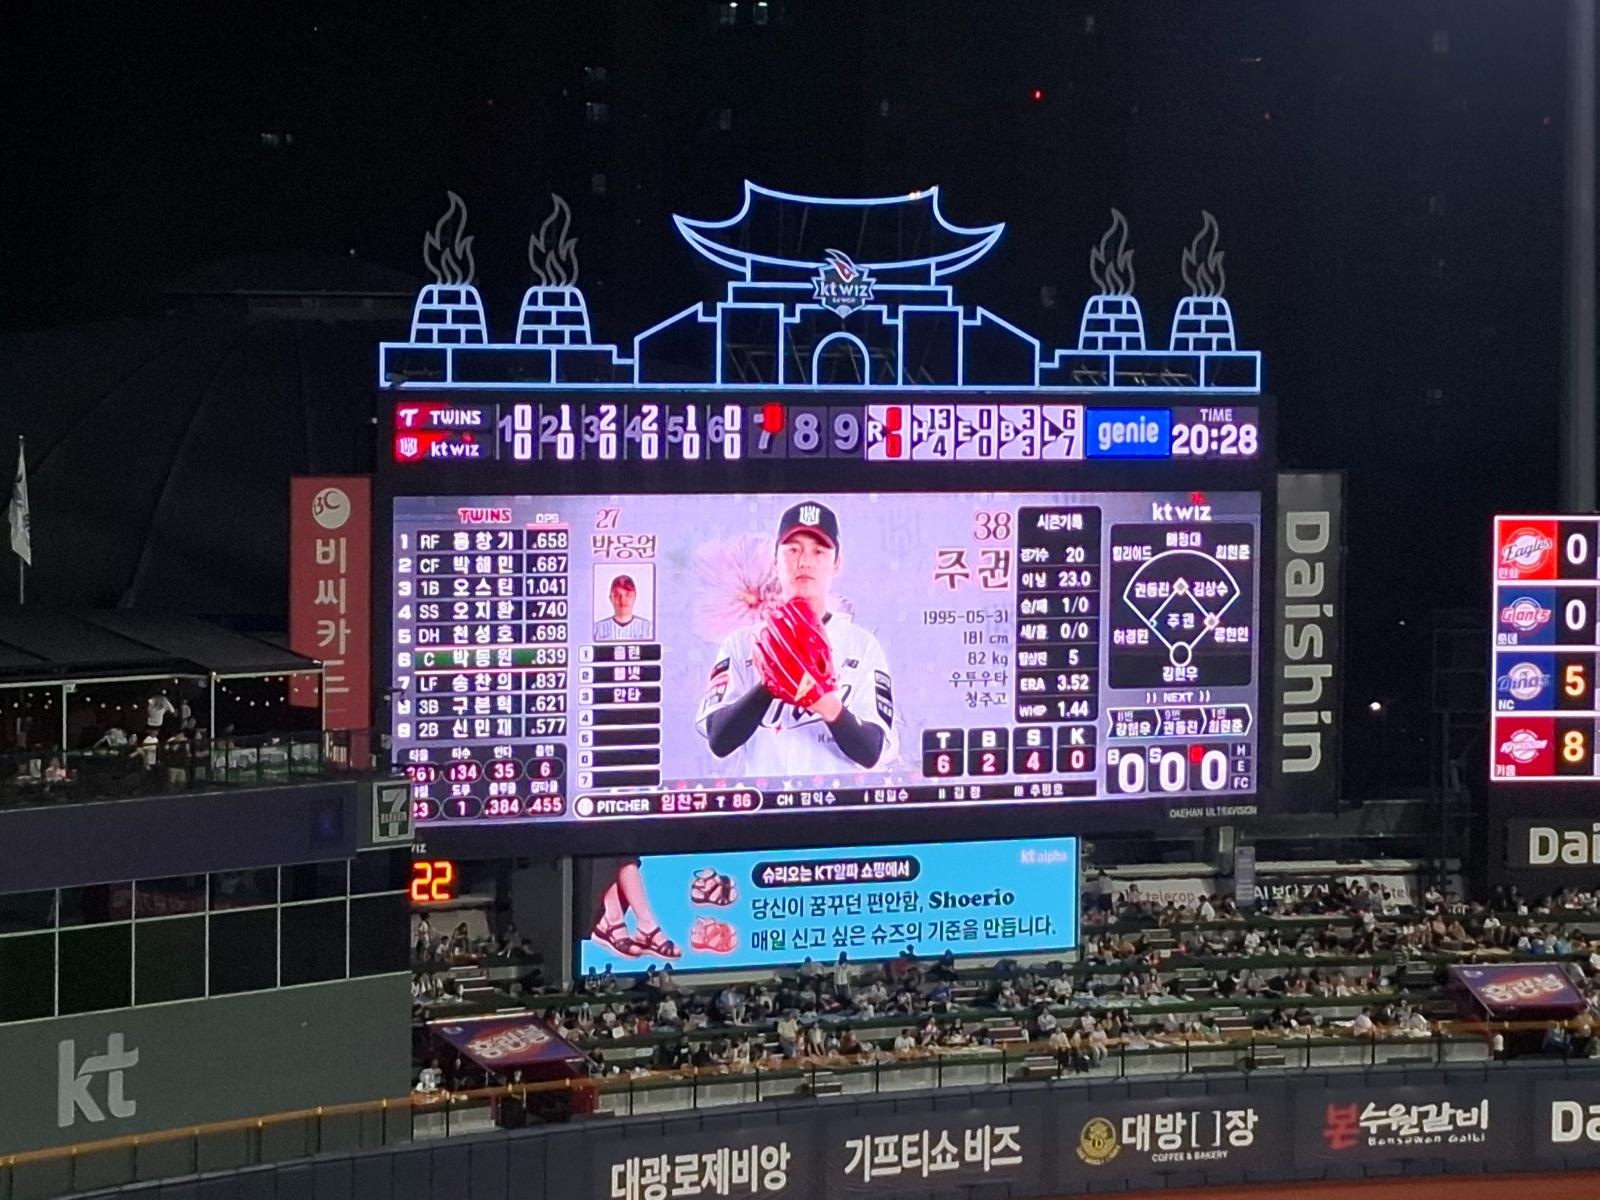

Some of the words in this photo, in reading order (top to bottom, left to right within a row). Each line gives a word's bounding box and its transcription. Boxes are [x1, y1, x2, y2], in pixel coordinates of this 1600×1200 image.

[839, 284, 868, 296] wiz
[430, 410, 481, 425] TWINS
[514, 404, 531, 430] 0
[560, 404, 571, 430] 1
[600, 404, 616, 430] 2
[641, 405, 658, 431] 2
[686, 405, 696, 431] 1
[724, 405, 741, 431] 0
[979, 409, 991, 430] 0
[1022, 409, 1035, 430] 3
[1063, 408, 1076, 430] 6
[1200, 408, 1232, 422] TIME
[794, 413, 819, 450] 8
[834, 413, 858, 450] 9
[868, 421, 883, 441] R
[913, 421, 928, 441] H
[958, 422, 972, 442] E
[1001, 422, 1015, 442] B
[1044, 421, 1057, 442] L
[1098, 415, 1159, 451] genie
[1172, 424, 1258, 455] 20:28
[431, 442, 448, 456] kt
[449, 444, 479, 456] wiz
[514, 433, 531, 459] 0
[557, 433, 574, 459] 0
[600, 433, 616, 459] 0
[641, 433, 658, 459] 0
[683, 433, 699, 459] 0
[724, 433, 741, 459] 0
[933, 435, 947, 457] 4
[979, 436, 991, 457] 0
[1022, 436, 1035, 457] 3
[1063, 436, 1076, 457] 7
[458, 508, 512, 524] TWINS
[596, 508, 620, 529] 27
[1152, 502, 1173, 521] kt
[1174, 505, 1212, 521] wiz
[974, 511, 1011, 541] 38
[400, 534, 408, 549] 1
[420, 534, 440, 549] RF
[532, 532, 567, 549] .658
[592, 535, 656, 559] 박동원
[1503, 537, 1552, 561] Eagles
[1567, 533, 1588, 564] 0
[1066, 547, 1084, 562] 20
[398, 558, 412, 573] 2
[420, 559, 440, 573] CF
[532, 556, 567, 572] .687
[398, 581, 411, 596] 3
[421, 581, 440, 595] 1B
[453, 578, 514, 596] 오스틴
[527, 579, 566, 594] 1.041
[1058, 571, 1091, 587] 23.0
[398, 605, 411, 619] 4
[419, 604, 439, 619] SS
[532, 602, 567, 618] .740
[1062, 597, 1088, 613] 1/0
[924, 610, 1008, 624] 1995-05-31
[1566, 599, 1586, 630] 0
[398, 628, 411, 644] 5
[419, 628, 440, 643] DH
[531, 625, 567, 641] .698
[963, 631, 982, 644] 181
[989, 634, 1008, 644] cm
[1060, 622, 1088, 639] 0/0
[1282, 511, 1333, 773] Daishin
[398, 652, 411, 667] 6
[424, 653, 435, 666] C
[531, 649, 566, 665] .839
[968, 652, 986, 665] 82
[992, 651, 1008, 667] kg
[1068, 649, 1079, 665] 5
[420, 676, 438, 691] LF
[531, 673, 566, 689] .837
[949, 670, 1008, 688] 우투우타
[1020, 678, 1045, 691] ERA
[1057, 674, 1089, 691] 3.52
[1565, 666, 1585, 696] 5
[419, 700, 439, 714] 3B
[531, 696, 564, 712] .621
[1163, 692, 1193, 703] NEXT
[1499, 700, 1515, 710] NC
[1058, 700, 1088, 717] 1.44
[419, 723, 439, 737] 2B
[531, 718, 565, 735] .577
[936, 732, 950, 749] T
[982, 730, 996, 747] B
[1027, 729, 1041, 746] S
[1071, 728, 1084, 745] K
[1564, 731, 1584, 762] 8
[1237, 745, 1246, 756] H
[494, 763, 514, 778] 35
[541, 762, 550, 776] 6
[937, 755, 950, 774] 6
[982, 753, 996, 772] 2
[1027, 751, 1040, 770] 4
[1071, 750, 1084, 769] 0
[1107, 749, 1120, 765] B
[1118, 753, 1145, 793] 0
[1149, 748, 1162, 763] S
[1159, 751, 1185, 791] 0
[1201, 750, 1227, 790] 0
[1237, 761, 1245, 772] E
[450, 764, 477, 781] 134
[1233, 777, 1249, 788] FC
[458, 801, 466, 816] 1
[485, 800, 520, 815] .384
[597, 799, 649, 813] PITCHER
[1530, 823, 1600, 864] Dai
[412, 861, 452, 901] 22
[762, 865, 812, 883] 슈리오는
[860, 861, 910, 878] 쇼핑에서
[752, 896, 804, 919] 당신이
[810, 892, 861, 916] 꿈꾸던
[867, 891, 923, 913] 편안함,
[928, 889, 1015, 909] Shoerio
[752, 929, 786, 951] 매일
[791, 928, 826, 950] 신고
[832, 926, 866, 947] 싶은
[871, 922, 922, 943] 슈즈의
[928, 919, 979, 941] 기준을
[983, 915, 1056, 939] 만듭니다.
[57, 1032, 139, 1128] kt
[844, 1129, 960, 1183] 기프티쇼
[964, 1124, 1023, 1172] 비즈
[1152, 1152, 1184, 1162] COFFEE
[1194, 1150, 1228, 1161] BAKERY
[611, 1142, 791, 1200] 대광로제비앙
